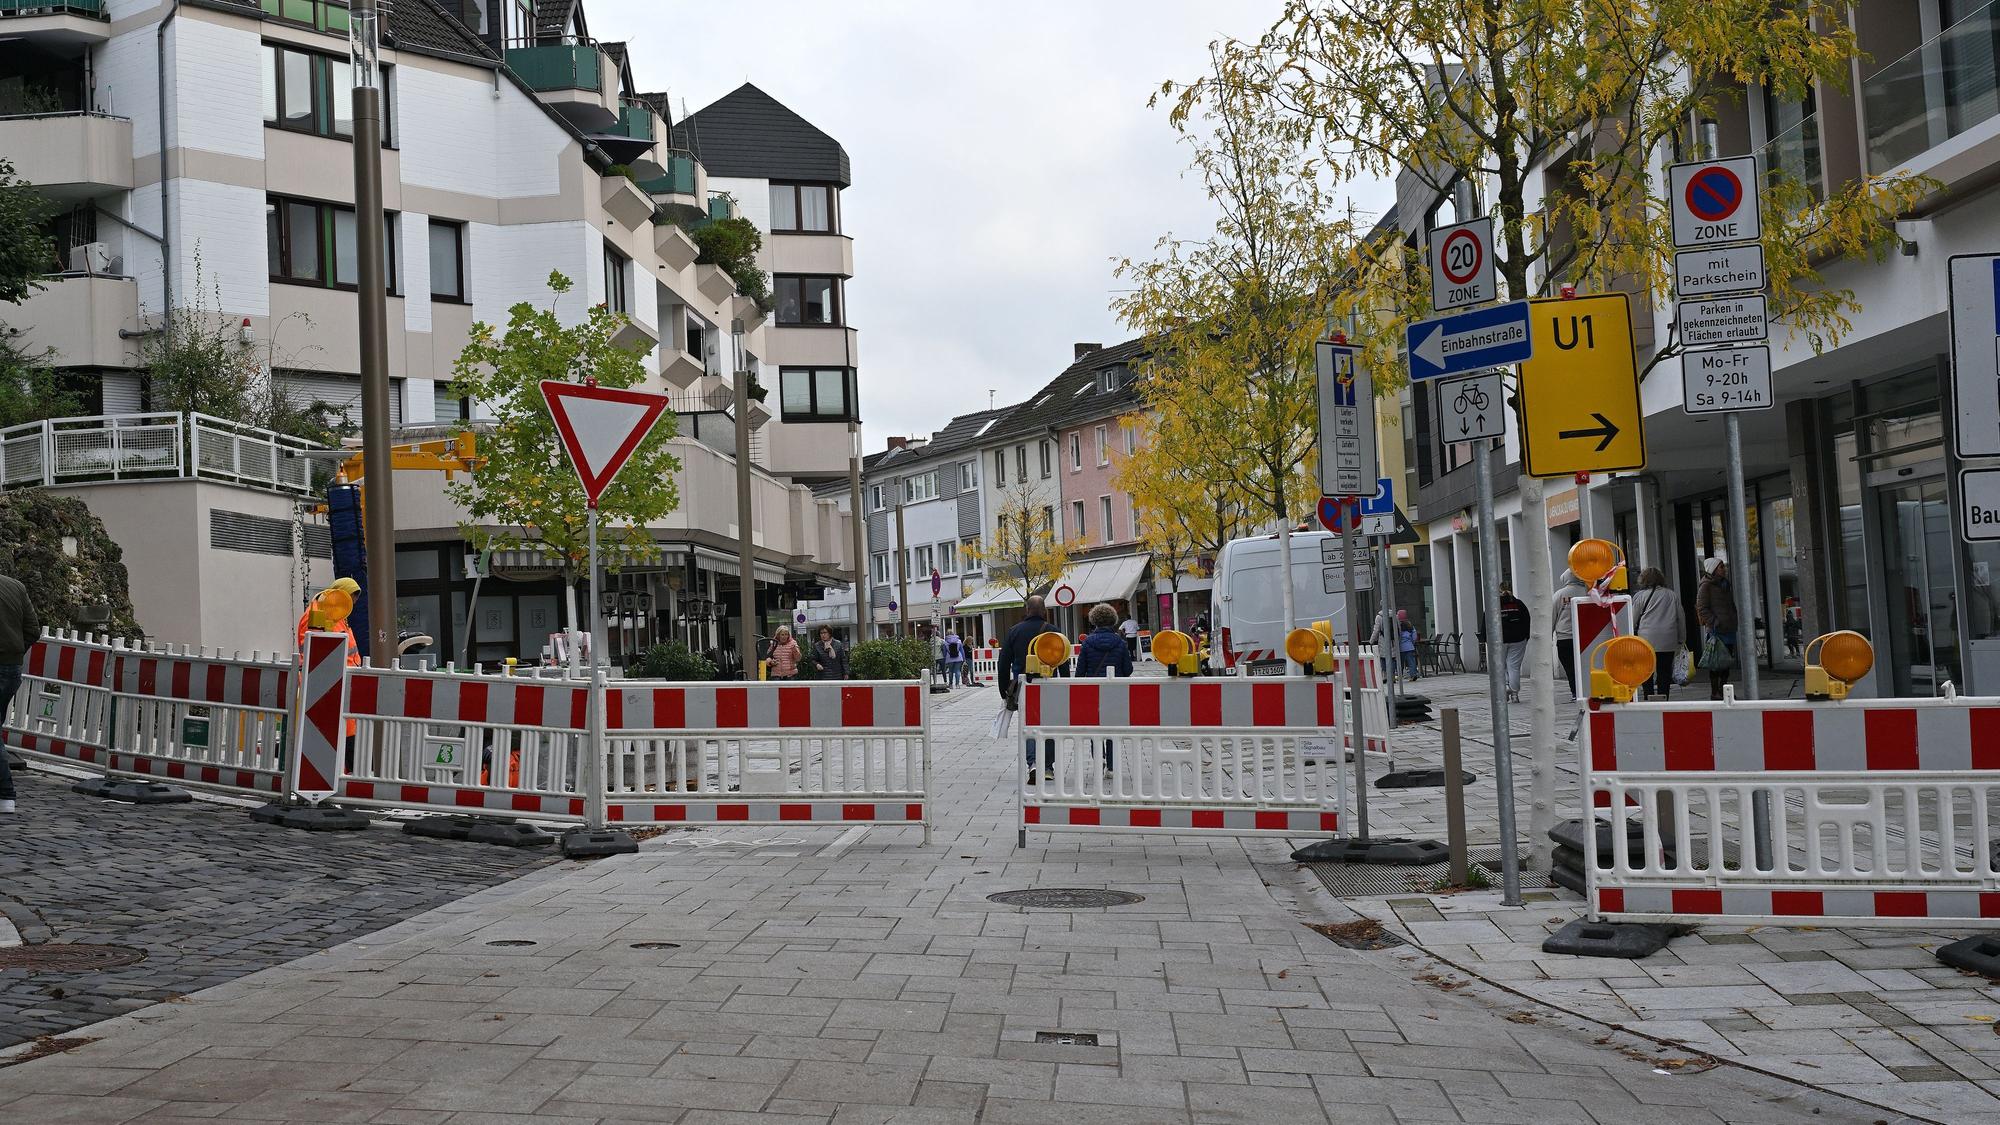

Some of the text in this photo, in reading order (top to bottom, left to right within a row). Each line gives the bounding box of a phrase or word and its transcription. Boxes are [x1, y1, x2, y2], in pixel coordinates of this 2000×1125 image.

[1695, 223, 1738, 240] ZONE
[1451, 243, 1474, 271] 20
[1708, 258, 1729, 270] mit
[1683, 269, 1757, 287] Parkschein
[1448, 285, 1480, 303] ZONE
[1700, 302, 1744, 316] Parken in
[1683, 314, 1763, 332] gekennzeichneten
[1441, 326, 1523, 353] Einbahnstraße
[1552, 315, 1594, 350] U1
[1688, 326, 1759, 341] Flächen erlaubt
[1702, 354, 1749, 369] Mo-Fr
[1706, 372, 1748, 387] 9-20h
[1696, 389, 1761, 406] Sa 9-14h
[1327, 553, 1336, 561] ab
